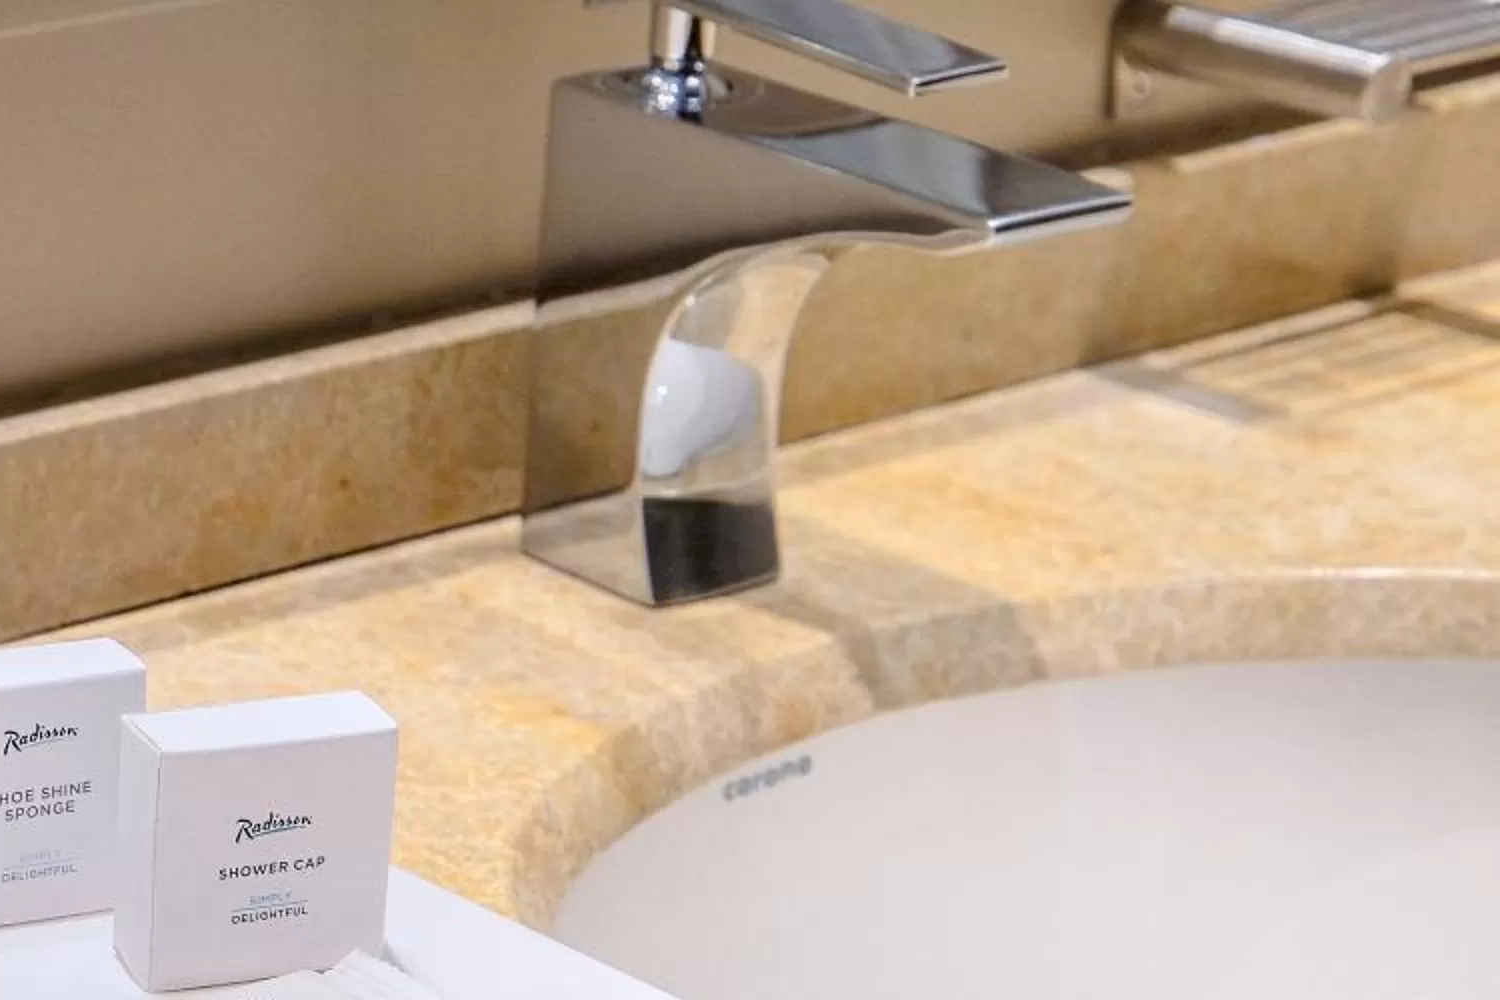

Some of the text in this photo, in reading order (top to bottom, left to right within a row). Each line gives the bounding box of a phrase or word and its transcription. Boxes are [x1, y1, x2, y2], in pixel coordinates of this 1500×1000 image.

[3, 723, 79, 756] Radisson
[41, 781, 92, 800] SHINE
[4, 800, 75, 822] SPONGE
[235, 811, 312, 844] Radisson
[1, 863, 77, 883] DELIGHTFUL
[219, 856, 326, 880] SHOWER CAP
[231, 906, 308, 925] DELIGHTFUL
